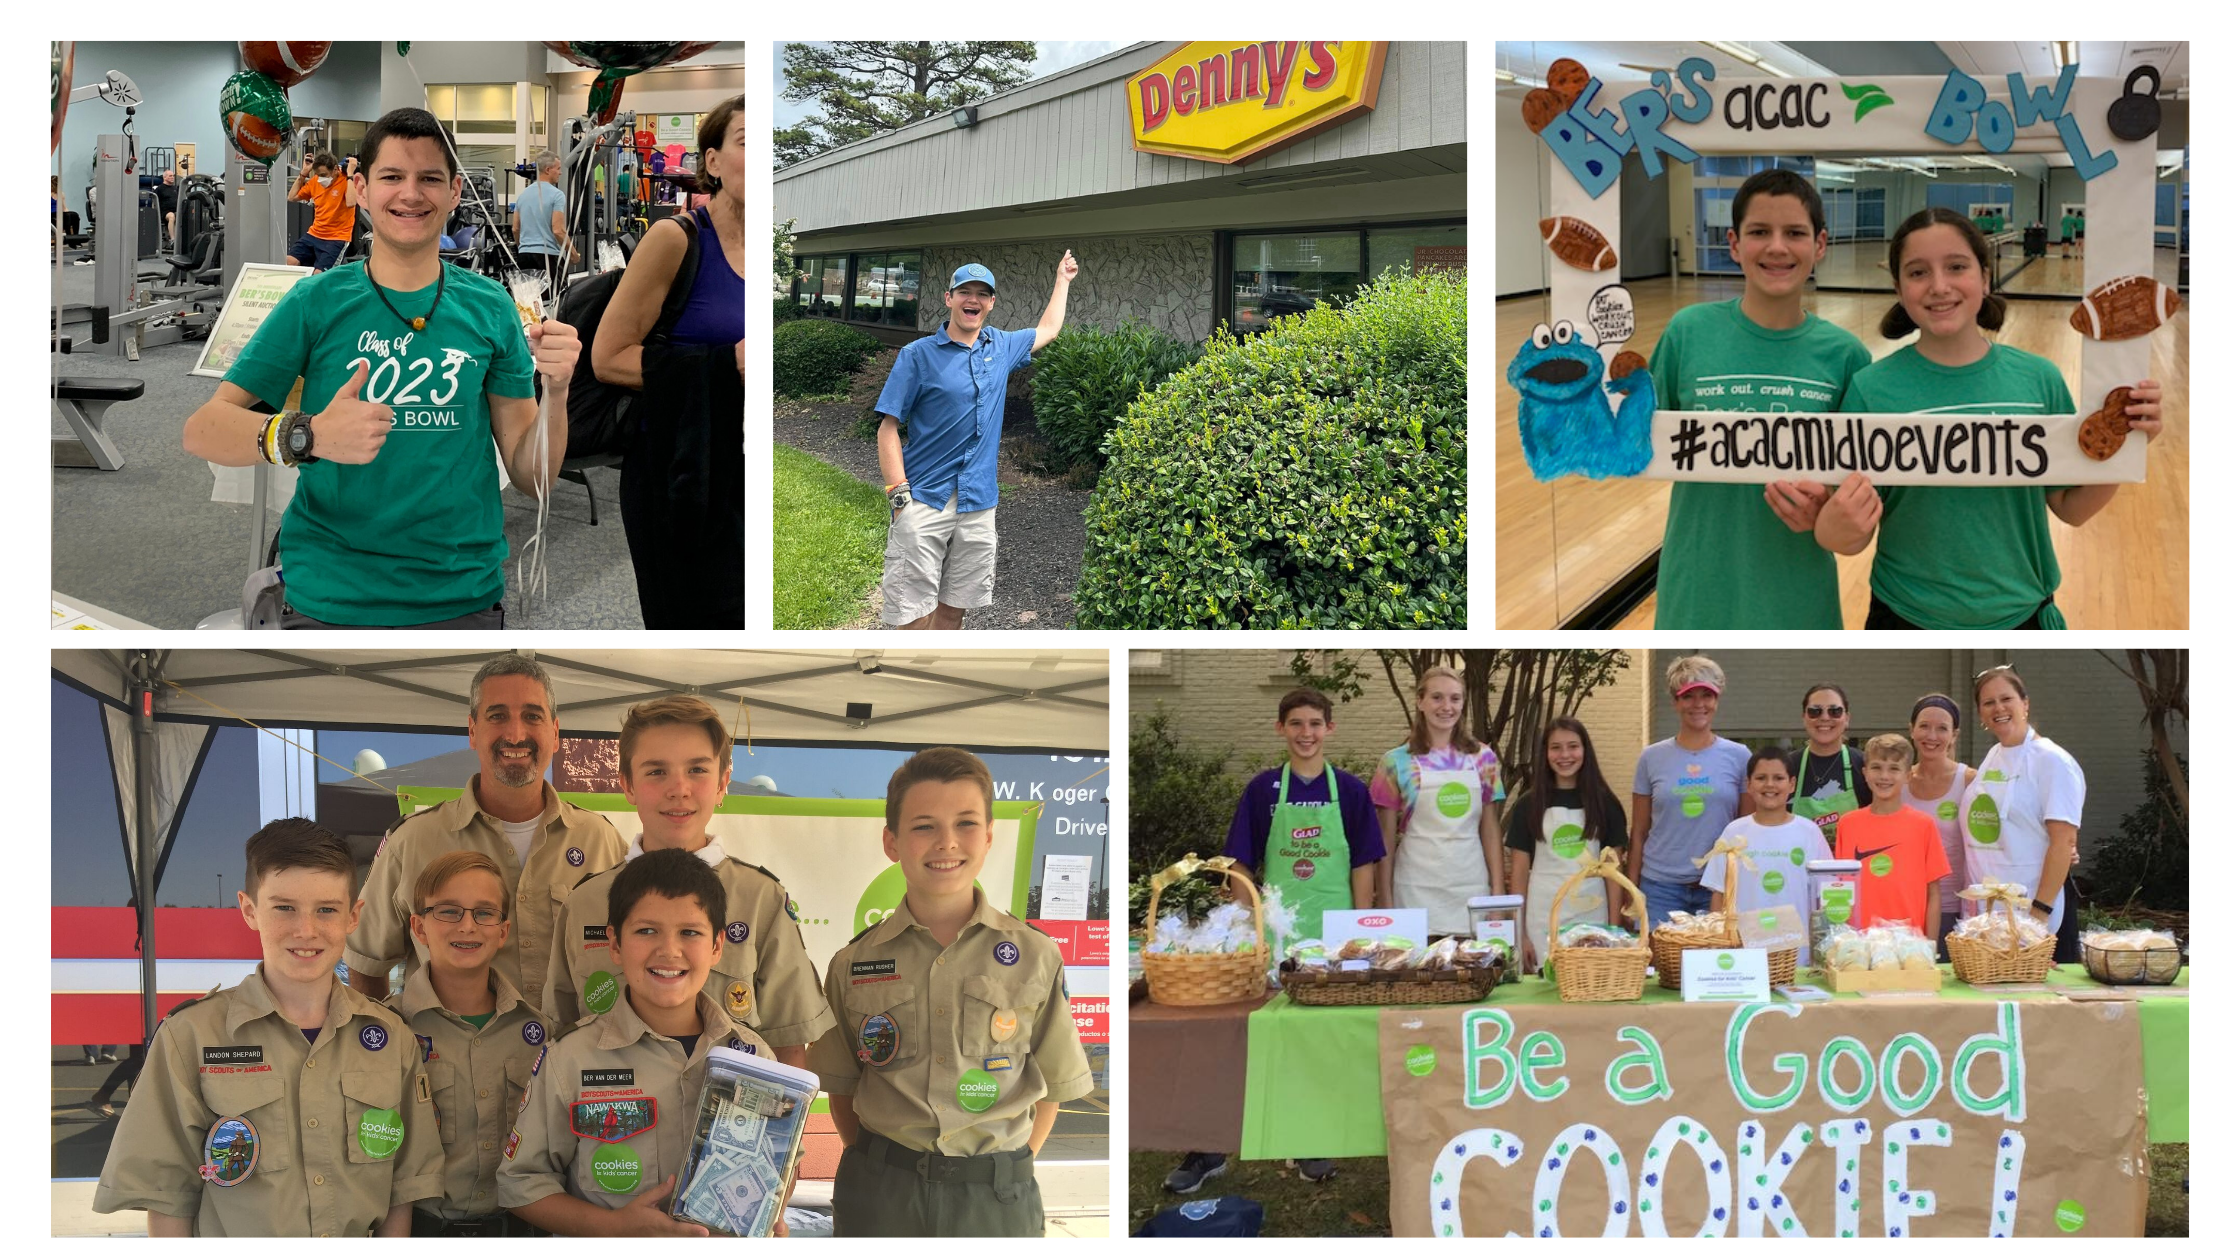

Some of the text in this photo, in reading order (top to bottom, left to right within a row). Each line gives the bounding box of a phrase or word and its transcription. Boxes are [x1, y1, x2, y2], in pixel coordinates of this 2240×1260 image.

[1138, 41, 1342, 134] Denny's
[1540, 57, 1715, 200] BER'S
[1724, 82, 1831, 131] acac
[258, 301, 276, 309] AUCTIO
[358, 331, 414, 357] Class of
[1695, 384, 1725, 396] work
[1760, 385, 1794, 396] crush
[405, 411, 459, 425] BOWL
[1671, 417, 2049, 478] #acacmidloevents
[1055, 816, 1108, 835] Drive
[1292, 829, 1320, 838] GLAD
[1279, 848, 1301, 857] Good
[1363, 917, 1388, 926] OXO
[587, 978, 614, 1003] cookies
[1070, 1002, 1109, 1014] citatio
[232, 1050, 261, 1058] SHEPARD
[243, 1064, 273, 1073] AMERICA
[1463, 1002, 2027, 1123] Be a Good
[583, 1074, 594, 1082] BER
[606, 1073, 617, 1081] DER
[618, 1072, 633, 1080] MEER
[619, 1088, 644, 1096] AMERICA
[959, 1082, 997, 1092] cookies
[361, 1122, 401, 1136] cookies
[594, 1159, 639, 1170] cookies
